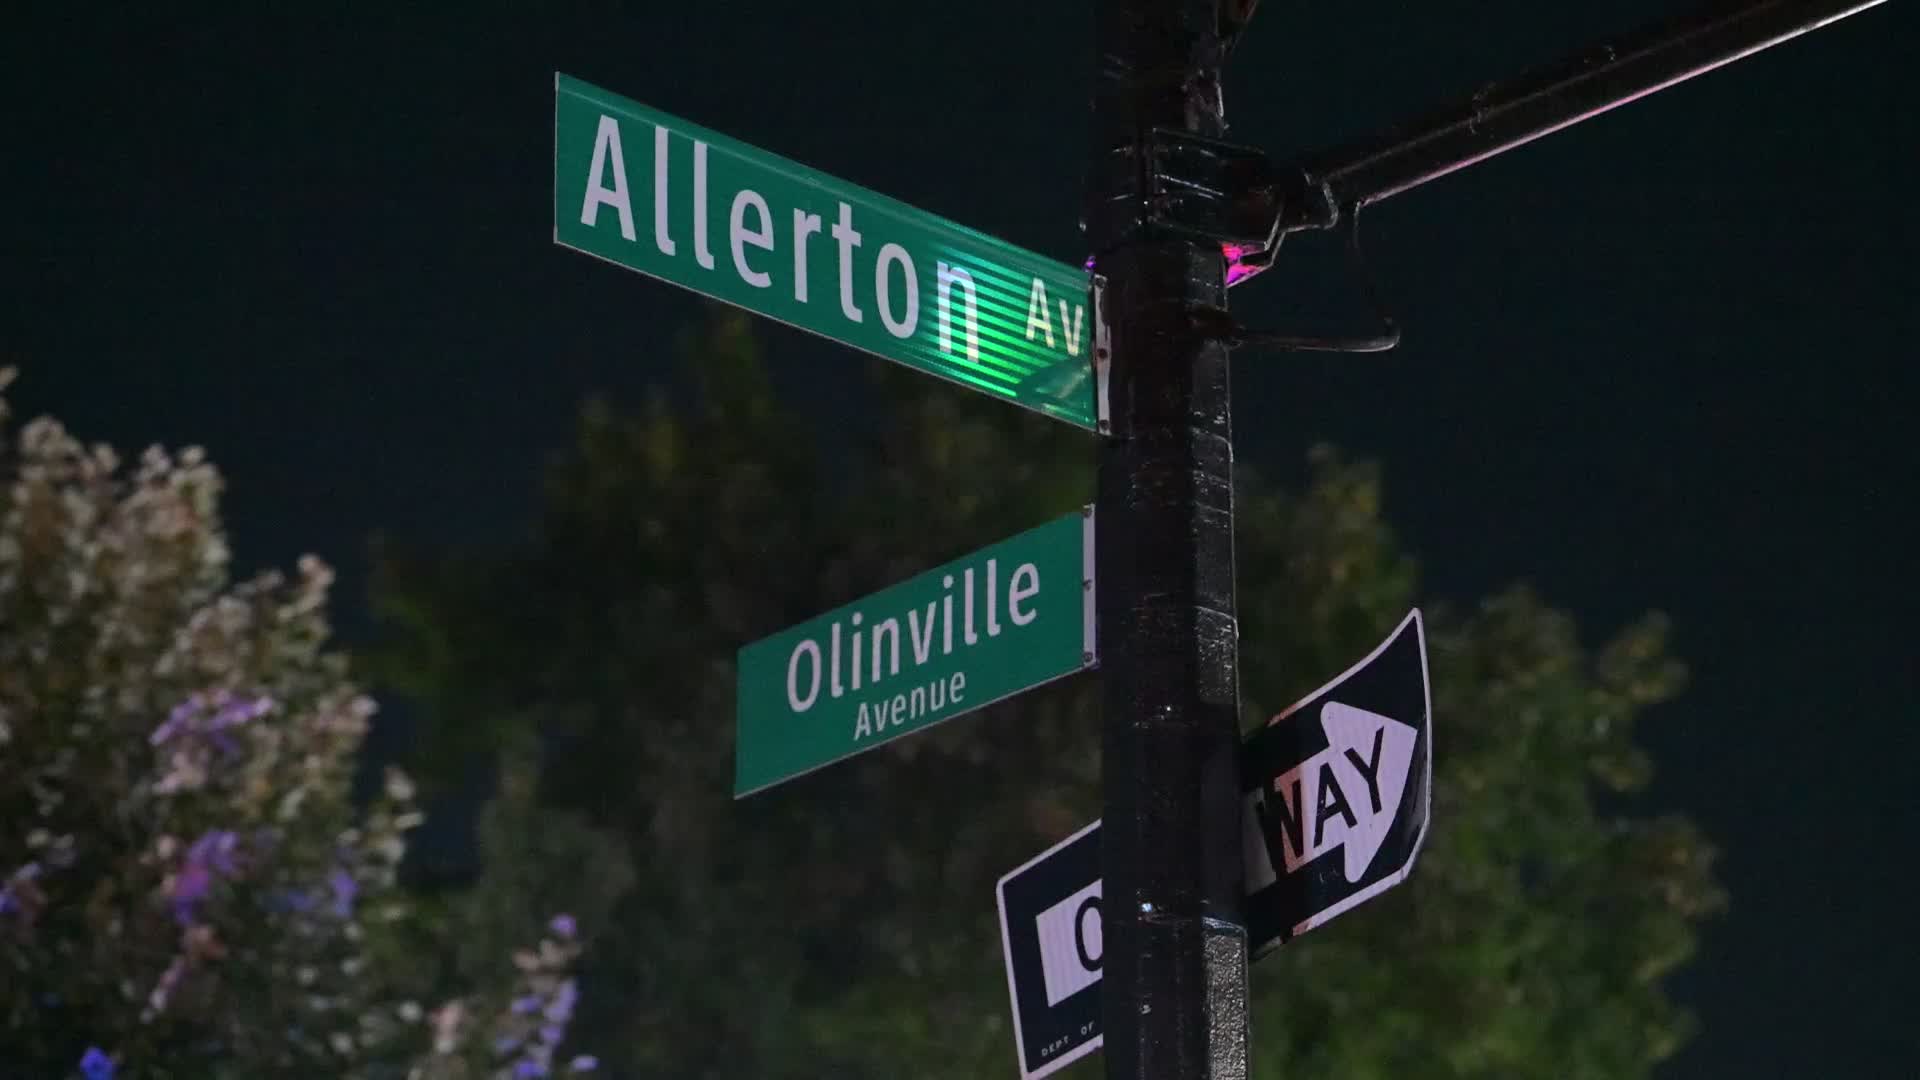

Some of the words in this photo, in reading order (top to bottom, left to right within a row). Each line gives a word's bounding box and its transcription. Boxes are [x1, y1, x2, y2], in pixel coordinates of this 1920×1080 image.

[581, 114, 980, 363] Allerton
[1026, 277, 1083, 356] Av
[787, 559, 1040, 713] Olinville
[854, 671, 966, 741] Avenue
[1255, 725, 1385, 870] WAY
